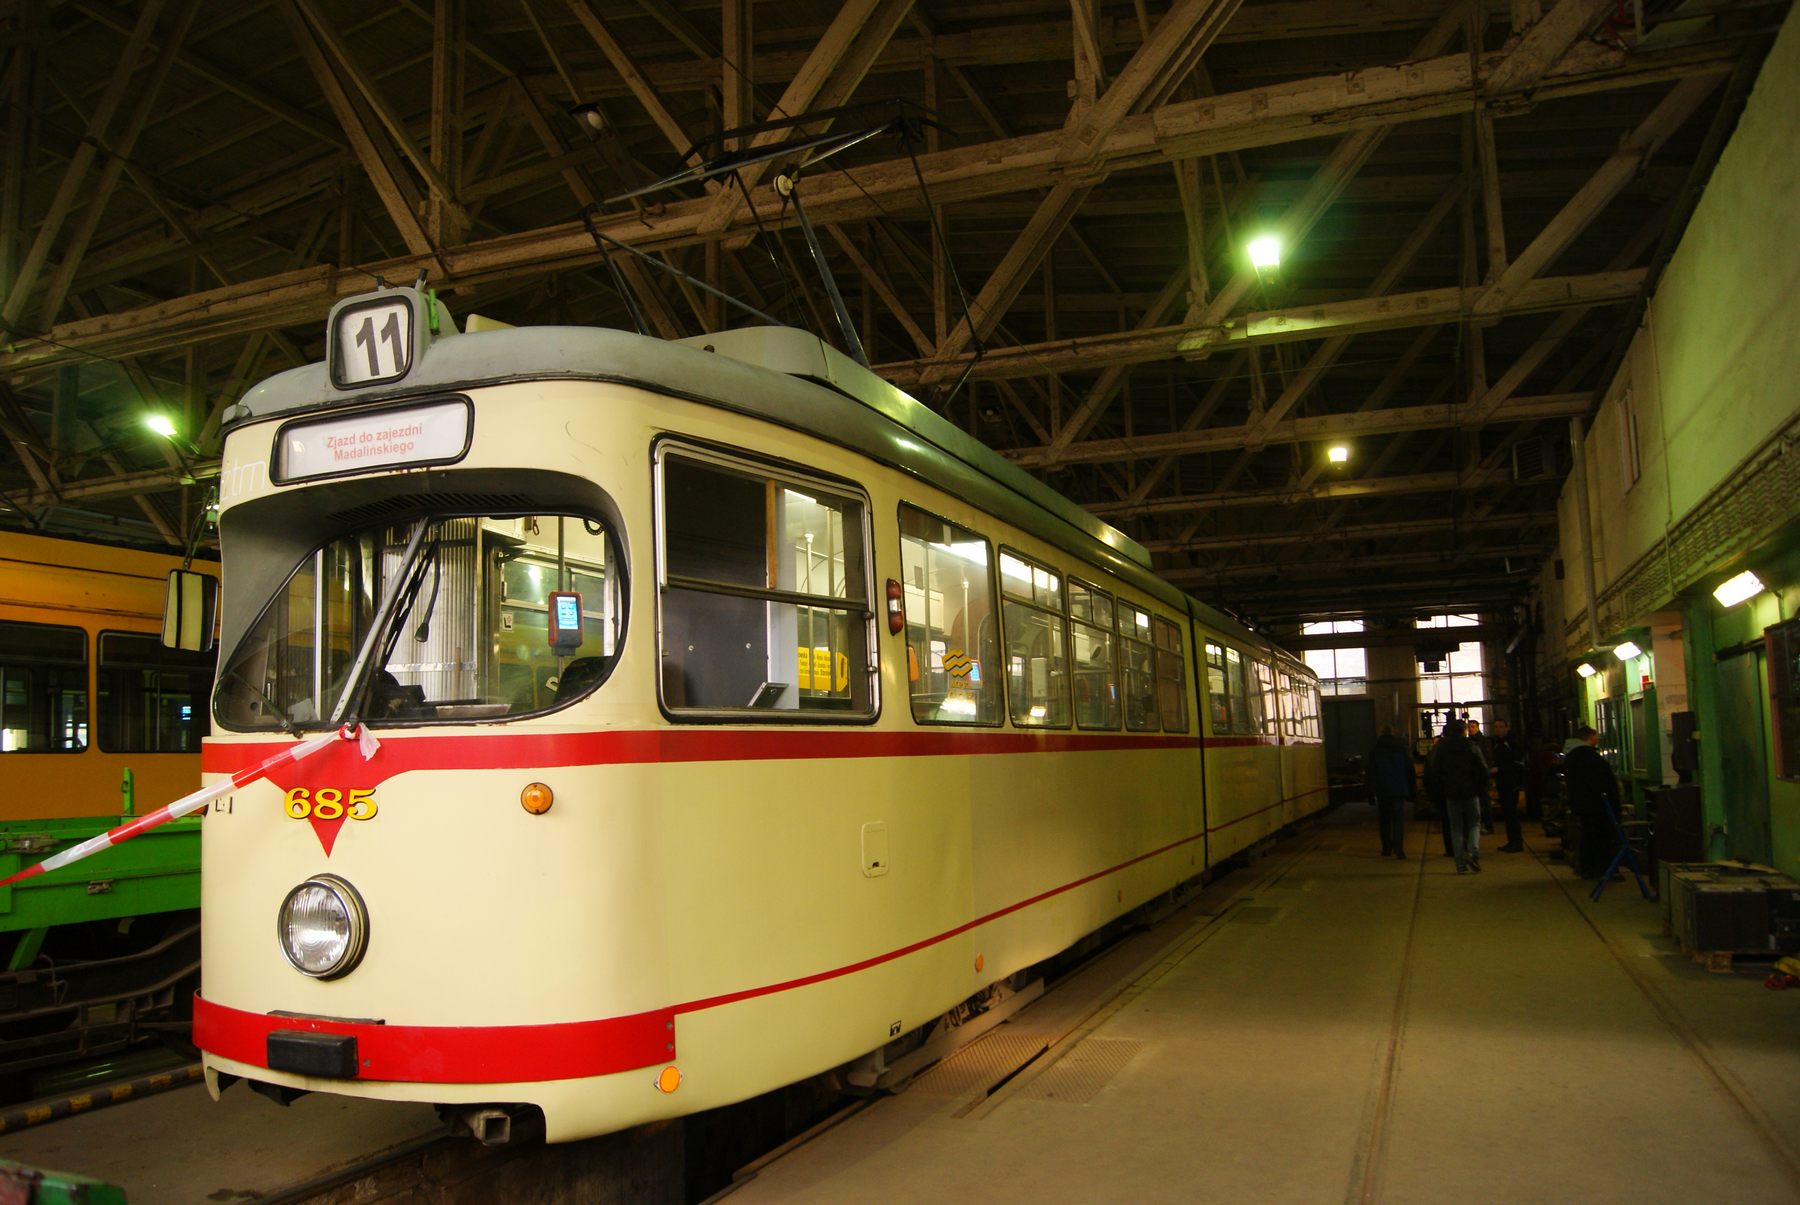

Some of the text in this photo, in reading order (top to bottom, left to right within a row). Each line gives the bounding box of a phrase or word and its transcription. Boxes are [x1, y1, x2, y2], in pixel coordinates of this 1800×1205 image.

[356, 312, 405, 377] 11
[327, 423, 423, 449] Zjazd do zajezdni
[334, 441, 414, 461] Madalińskiego
[284, 787, 379, 821] 685
